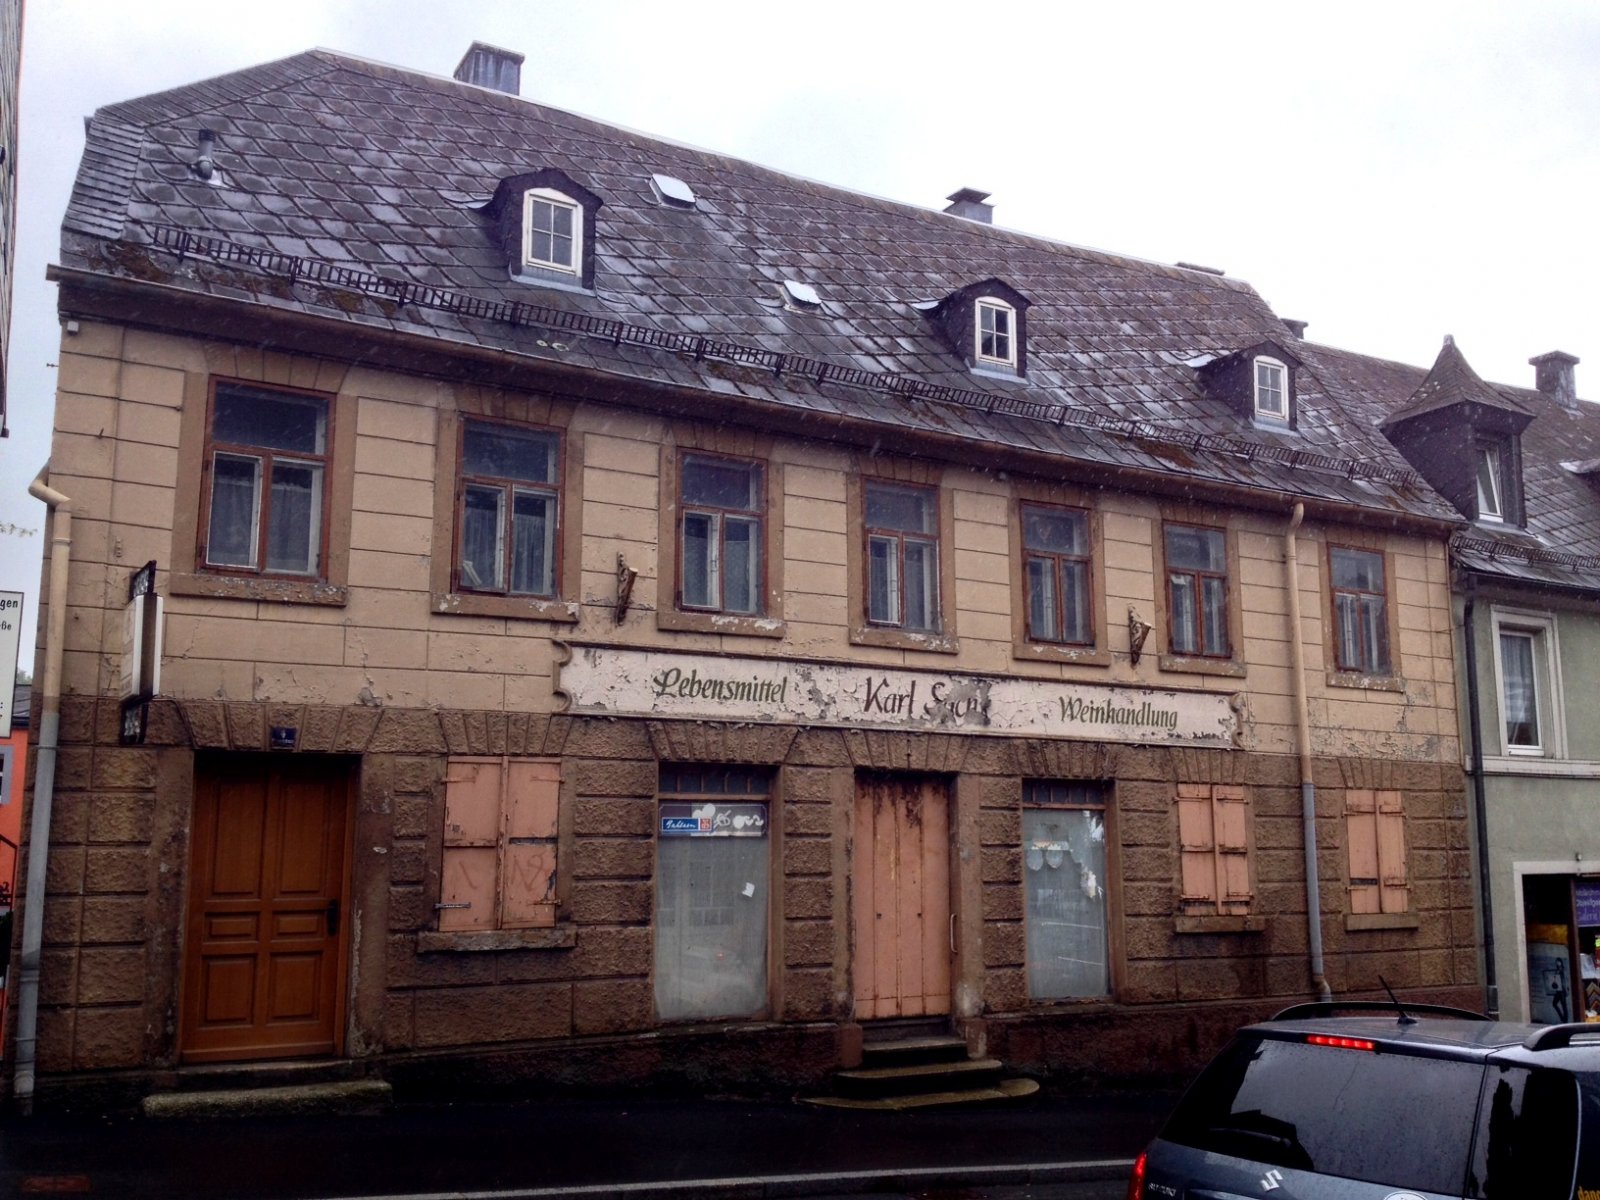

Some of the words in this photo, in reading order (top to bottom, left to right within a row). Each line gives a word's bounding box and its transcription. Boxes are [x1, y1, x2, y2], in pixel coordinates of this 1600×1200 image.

[653, 667, 788, 703] Lebensmittel
[864, 676, 916, 715] Karl
[1059, 696, 1178, 731] Weinhandlung
